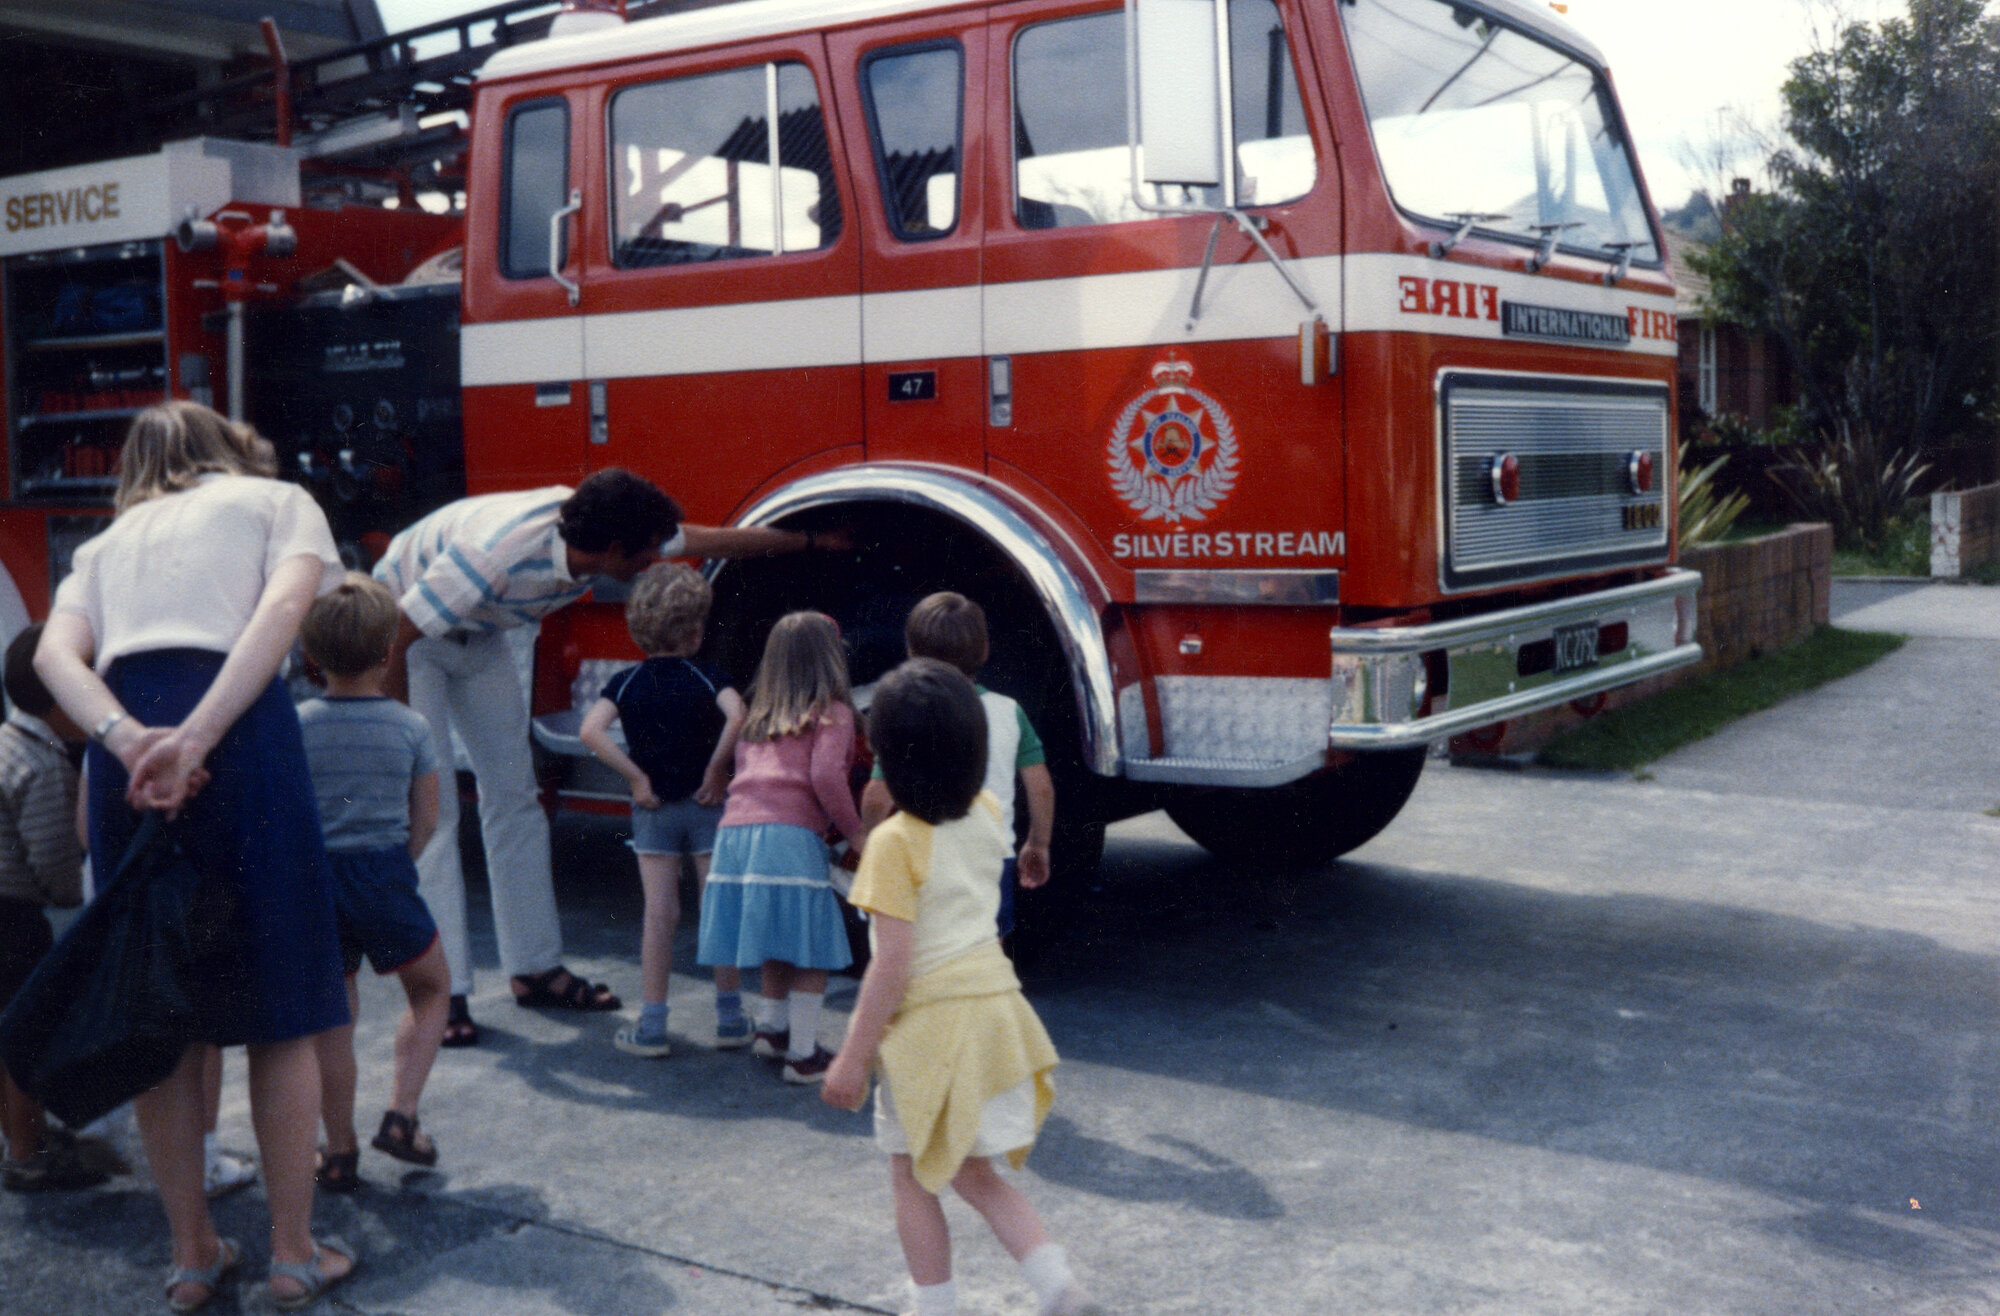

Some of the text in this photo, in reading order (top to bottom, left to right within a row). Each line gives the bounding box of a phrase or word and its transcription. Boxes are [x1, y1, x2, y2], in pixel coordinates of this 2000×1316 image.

[5, 182, 119, 232] SERVICE
[1510, 304, 1630, 341] INTERNATIONAL
[901, 377, 924, 396] 47
[1113, 531, 1346, 558] SILVERSTREAM
